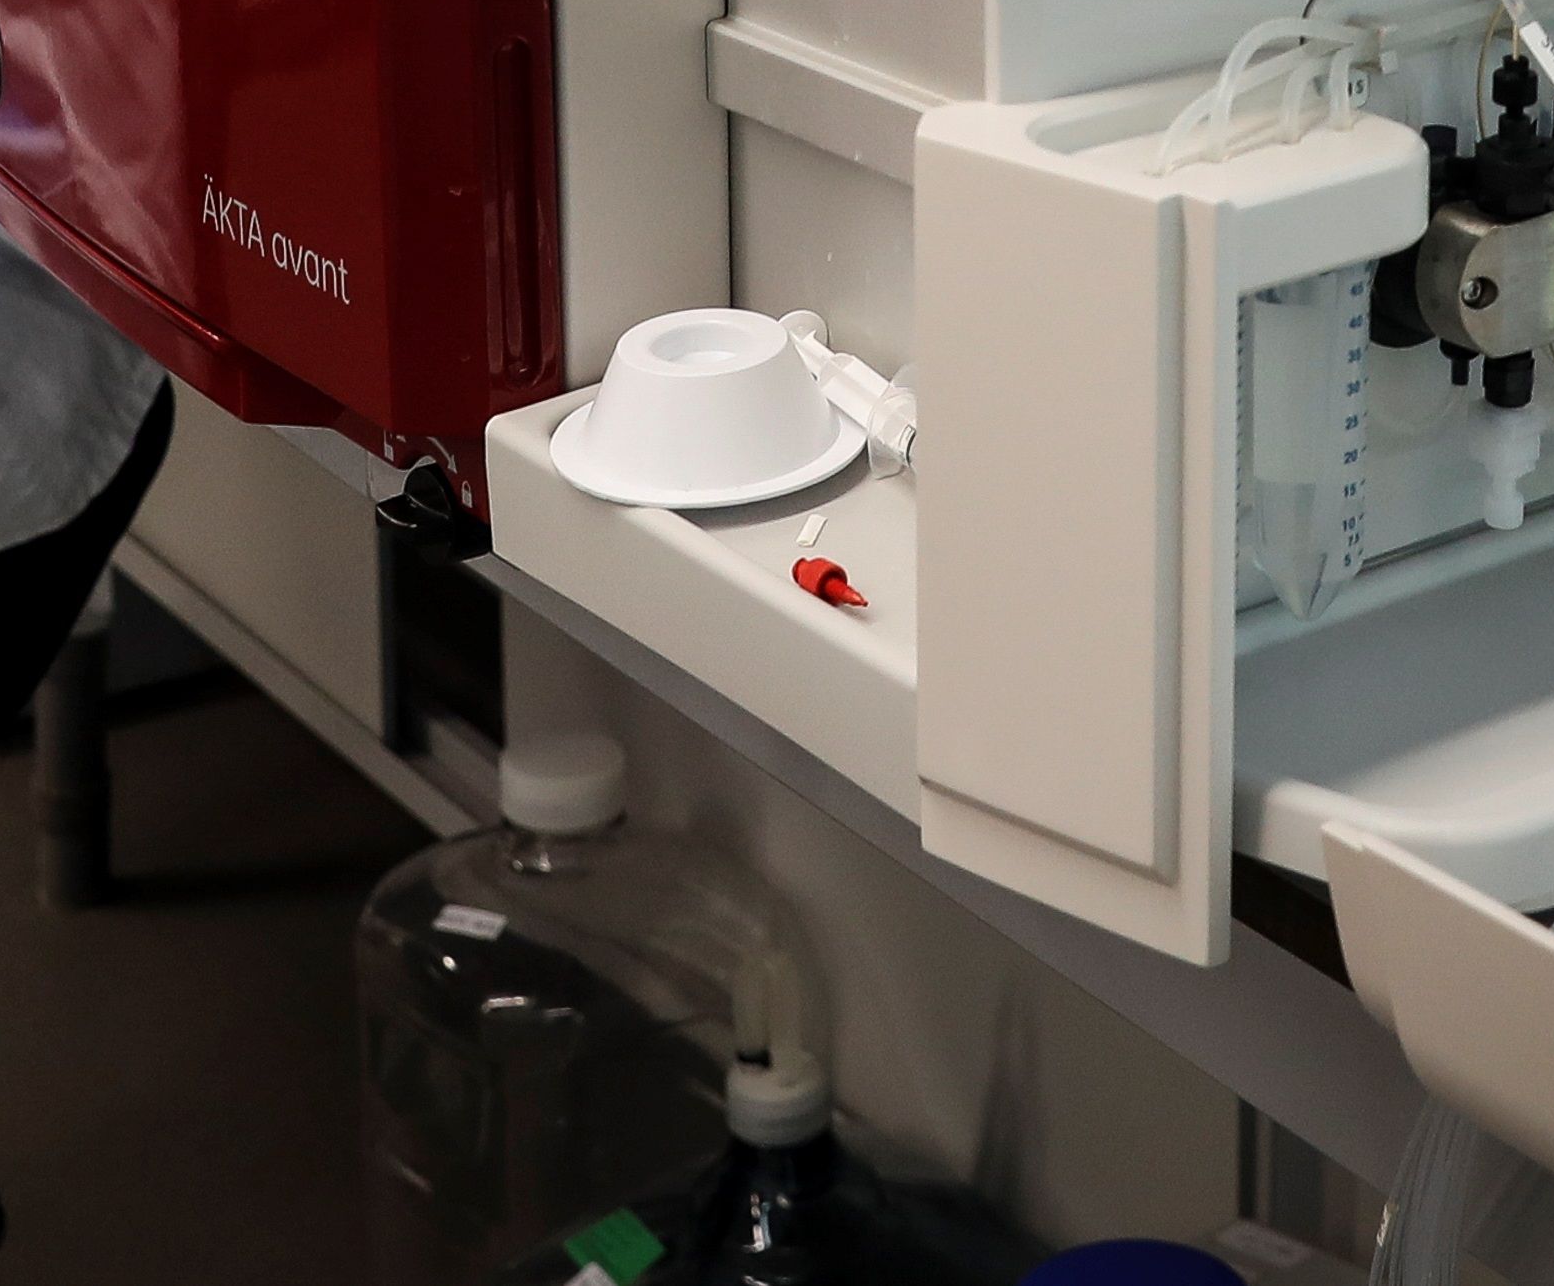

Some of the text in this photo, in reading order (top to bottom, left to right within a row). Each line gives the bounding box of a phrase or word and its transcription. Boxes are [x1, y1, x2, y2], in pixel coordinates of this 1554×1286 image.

[201, 173, 351, 305] ÄKTA avant
[1344, 448, 1358, 465] 20
[1342, 516, 1356, 532] 10
